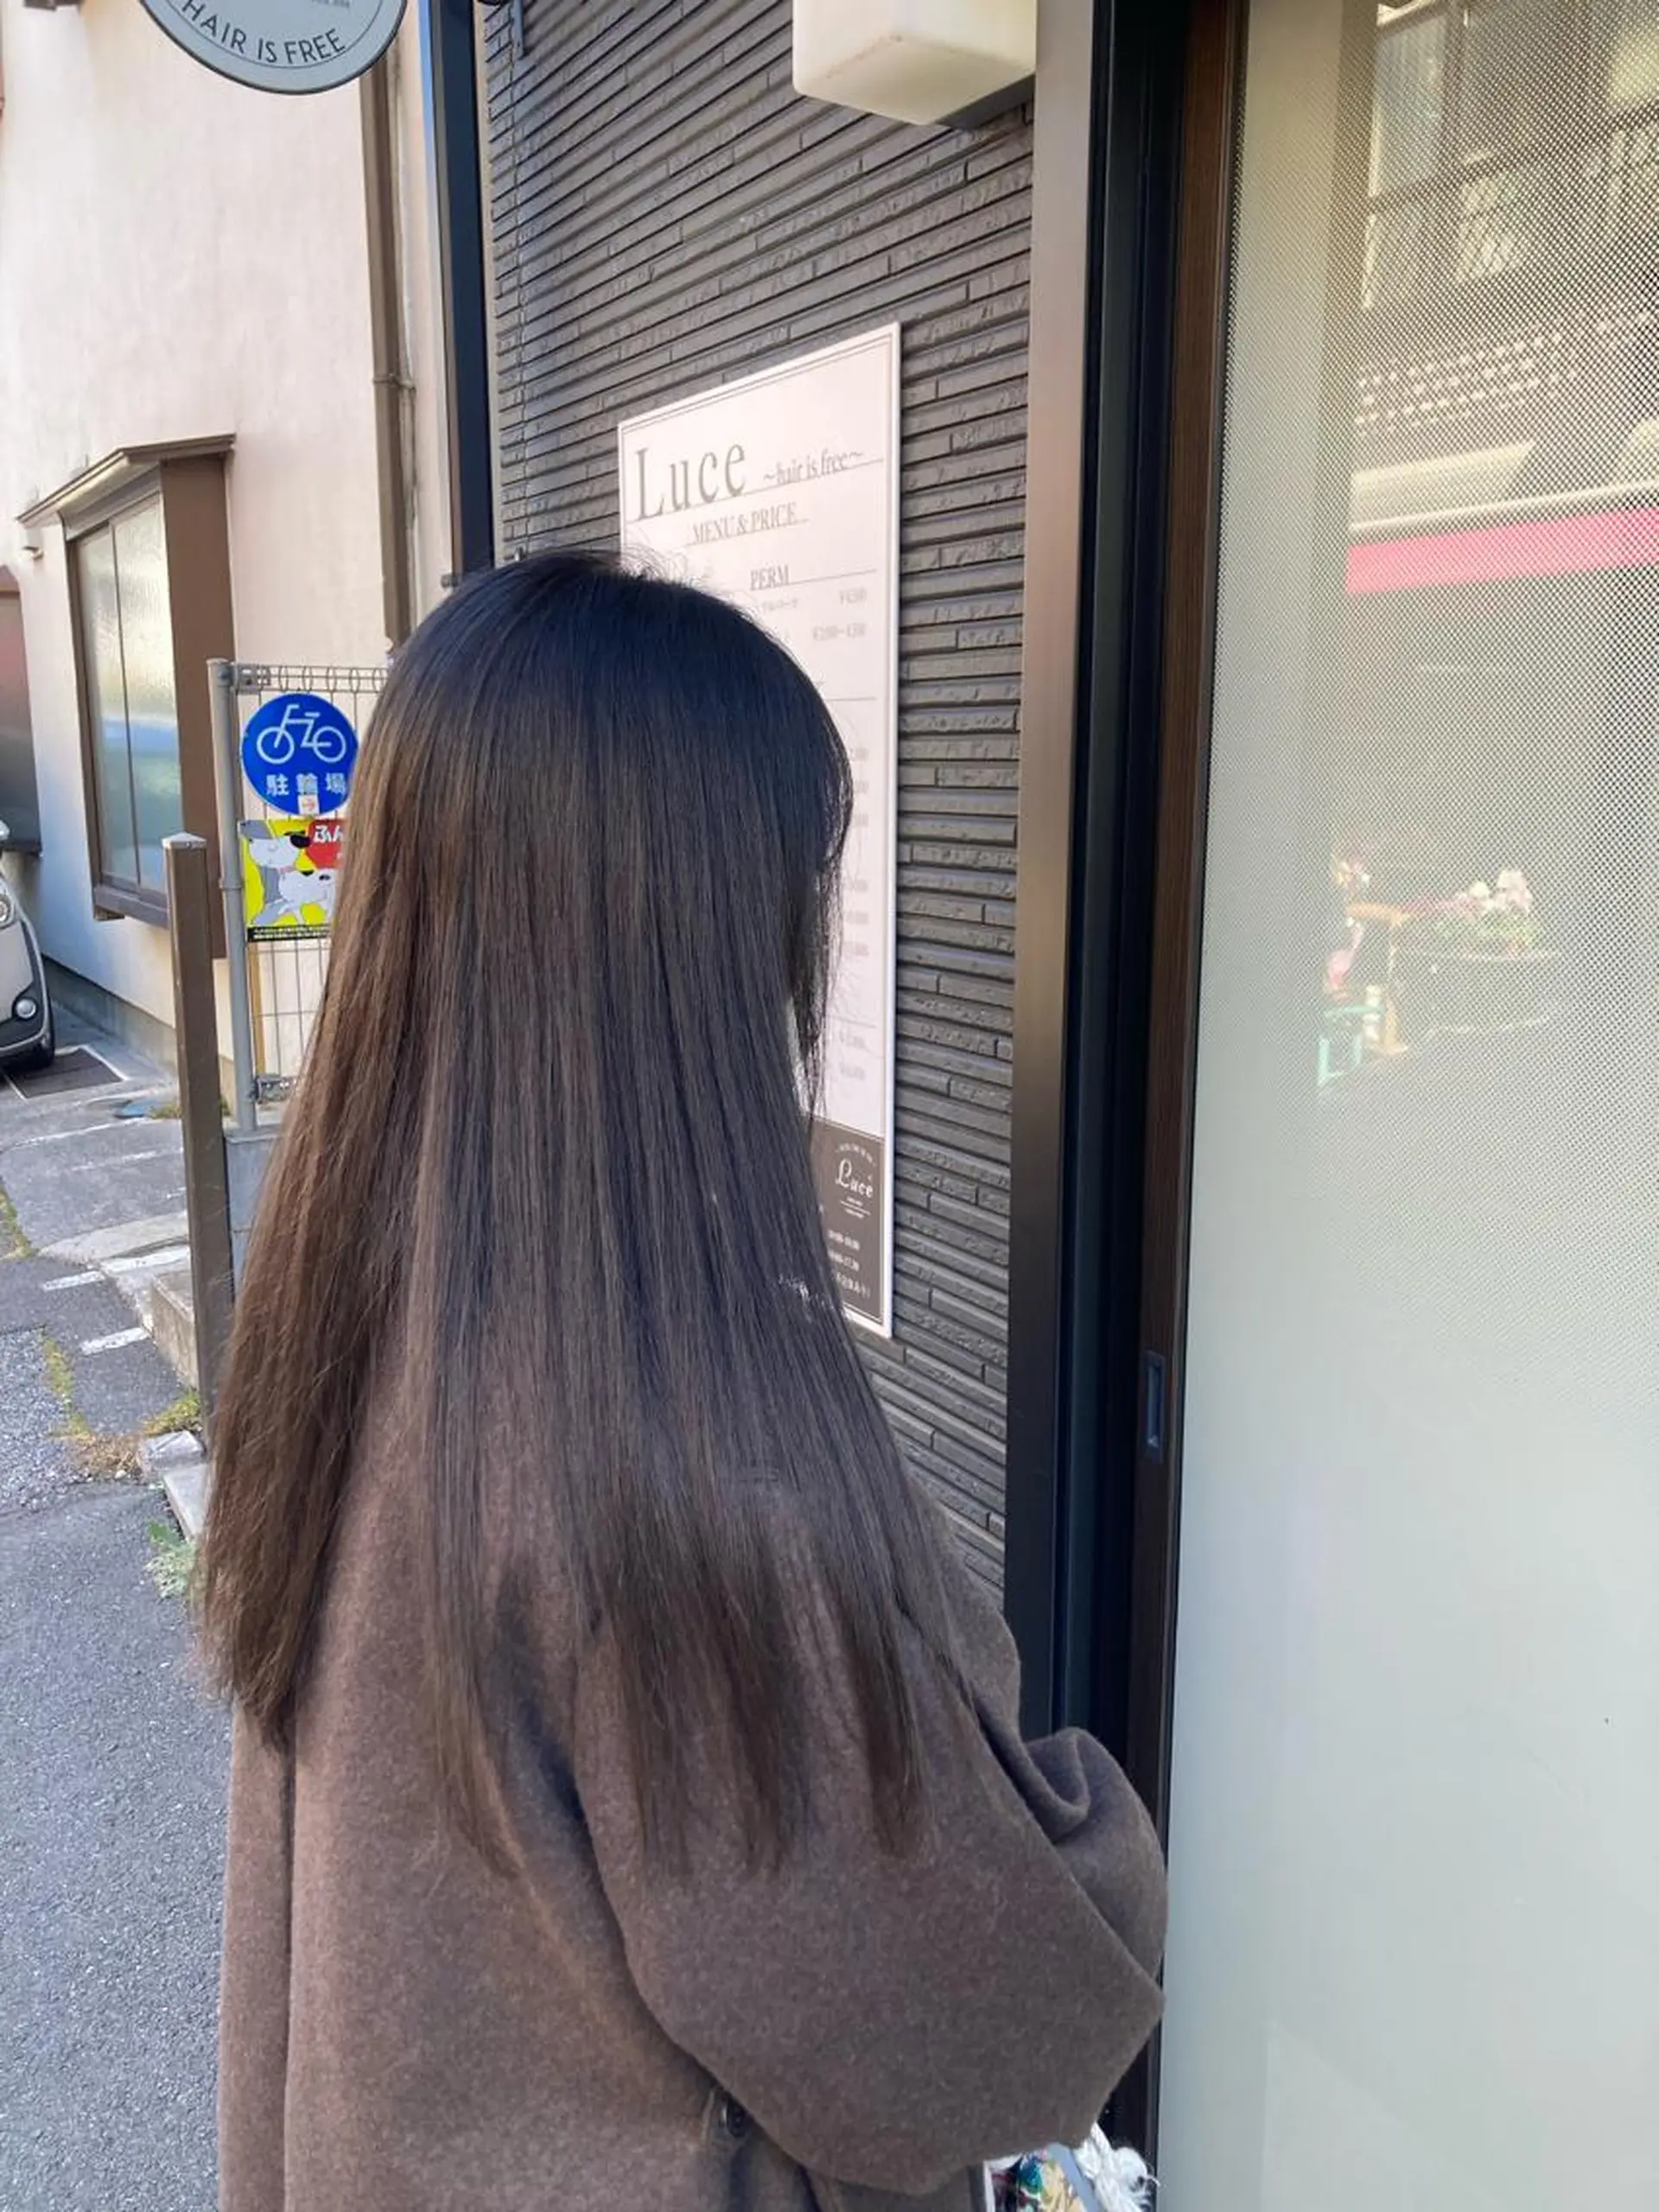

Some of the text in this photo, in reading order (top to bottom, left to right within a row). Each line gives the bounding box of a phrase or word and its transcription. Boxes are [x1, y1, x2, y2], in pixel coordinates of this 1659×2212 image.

[181, 0, 345, 65] HAIR IS FREE
[635, 442, 746, 520] Luce
[692, 501, 797, 545] MENU & PRICE
[750, 563, 791, 591] PERM
[835, 1157, 874, 1198] Luce
